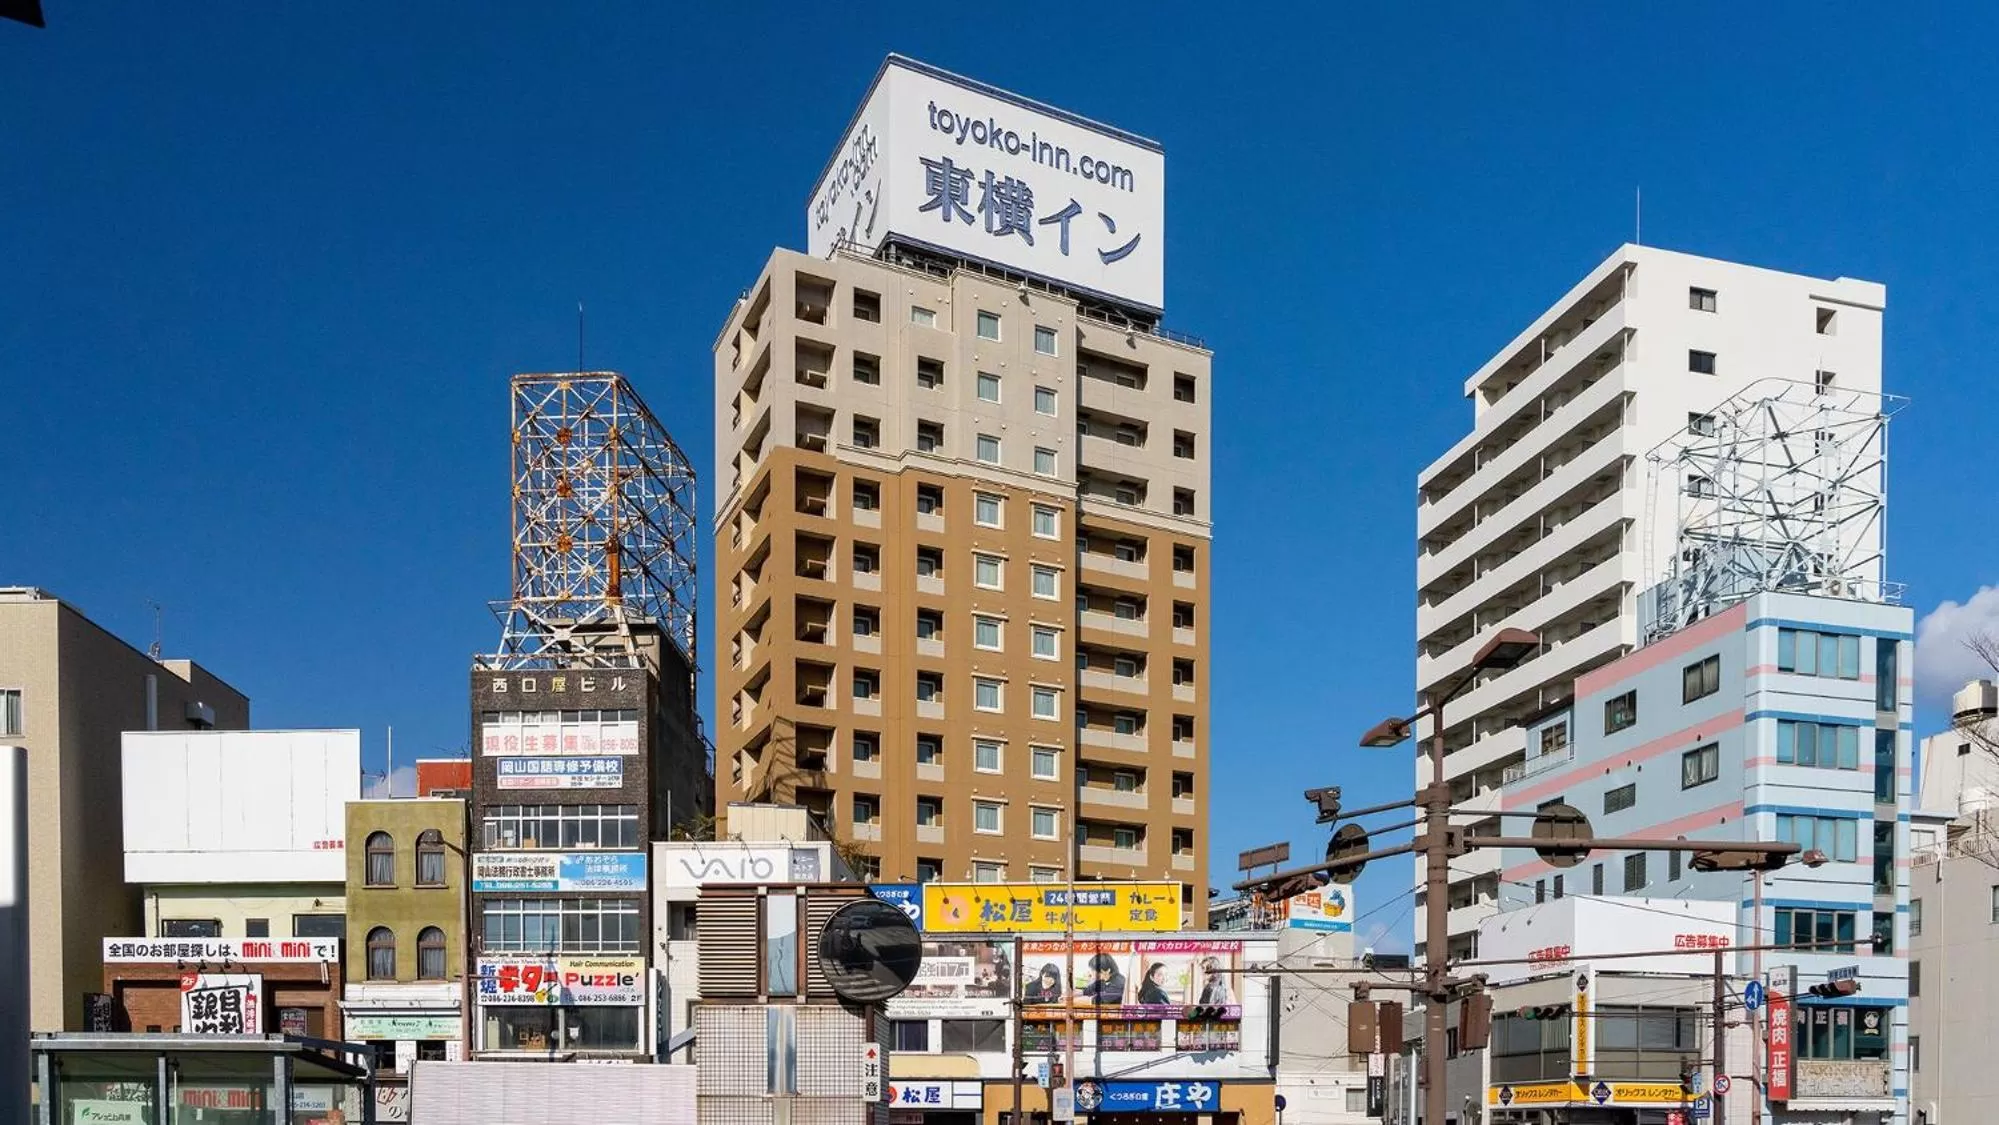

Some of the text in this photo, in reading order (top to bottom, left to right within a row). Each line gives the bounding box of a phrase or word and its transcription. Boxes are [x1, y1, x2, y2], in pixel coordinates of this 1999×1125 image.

[927, 100, 1134, 193] toyoko-inn.com
[919, 155, 1141, 266] 東横イン
[493, 676, 626, 693] 西口屋ビル
[485, 735, 578, 751] 現役生募集
[680, 858, 774, 880] VAIO
[980, 899, 1033, 922] 松屋
[1129, 909, 1158, 922] 定食
[1674, 934, 1729, 948] 広告募集中
[585, 960, 635, 968] Communication
[182, 976, 194, 986] 2F
[1772, 1008, 1788, 1045] 焼肉
[865, 1063, 878, 1097] 注意
[902, 1086, 942, 1104] 松屋
[1154, 1081, 1212, 1110] 庄や
